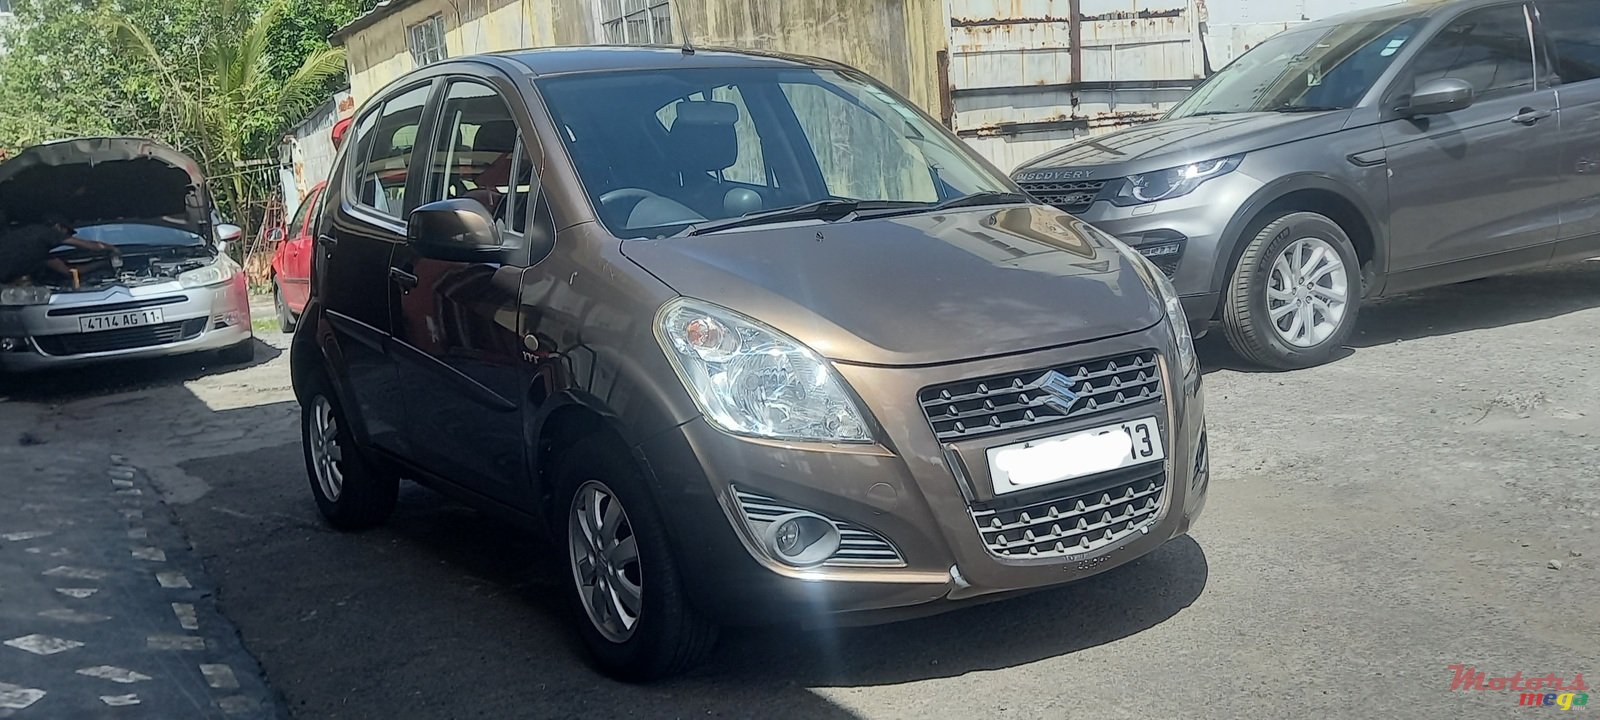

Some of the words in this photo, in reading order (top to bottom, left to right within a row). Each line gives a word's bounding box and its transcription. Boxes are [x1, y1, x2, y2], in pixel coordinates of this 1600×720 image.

[1016, 170, 1095, 181] DISCOVERY
[87, 315, 119, 330] 4714
[122, 313, 138, 326] AG
[142, 311, 156, 324] 11
[1124, 423, 1154, 460] 13
